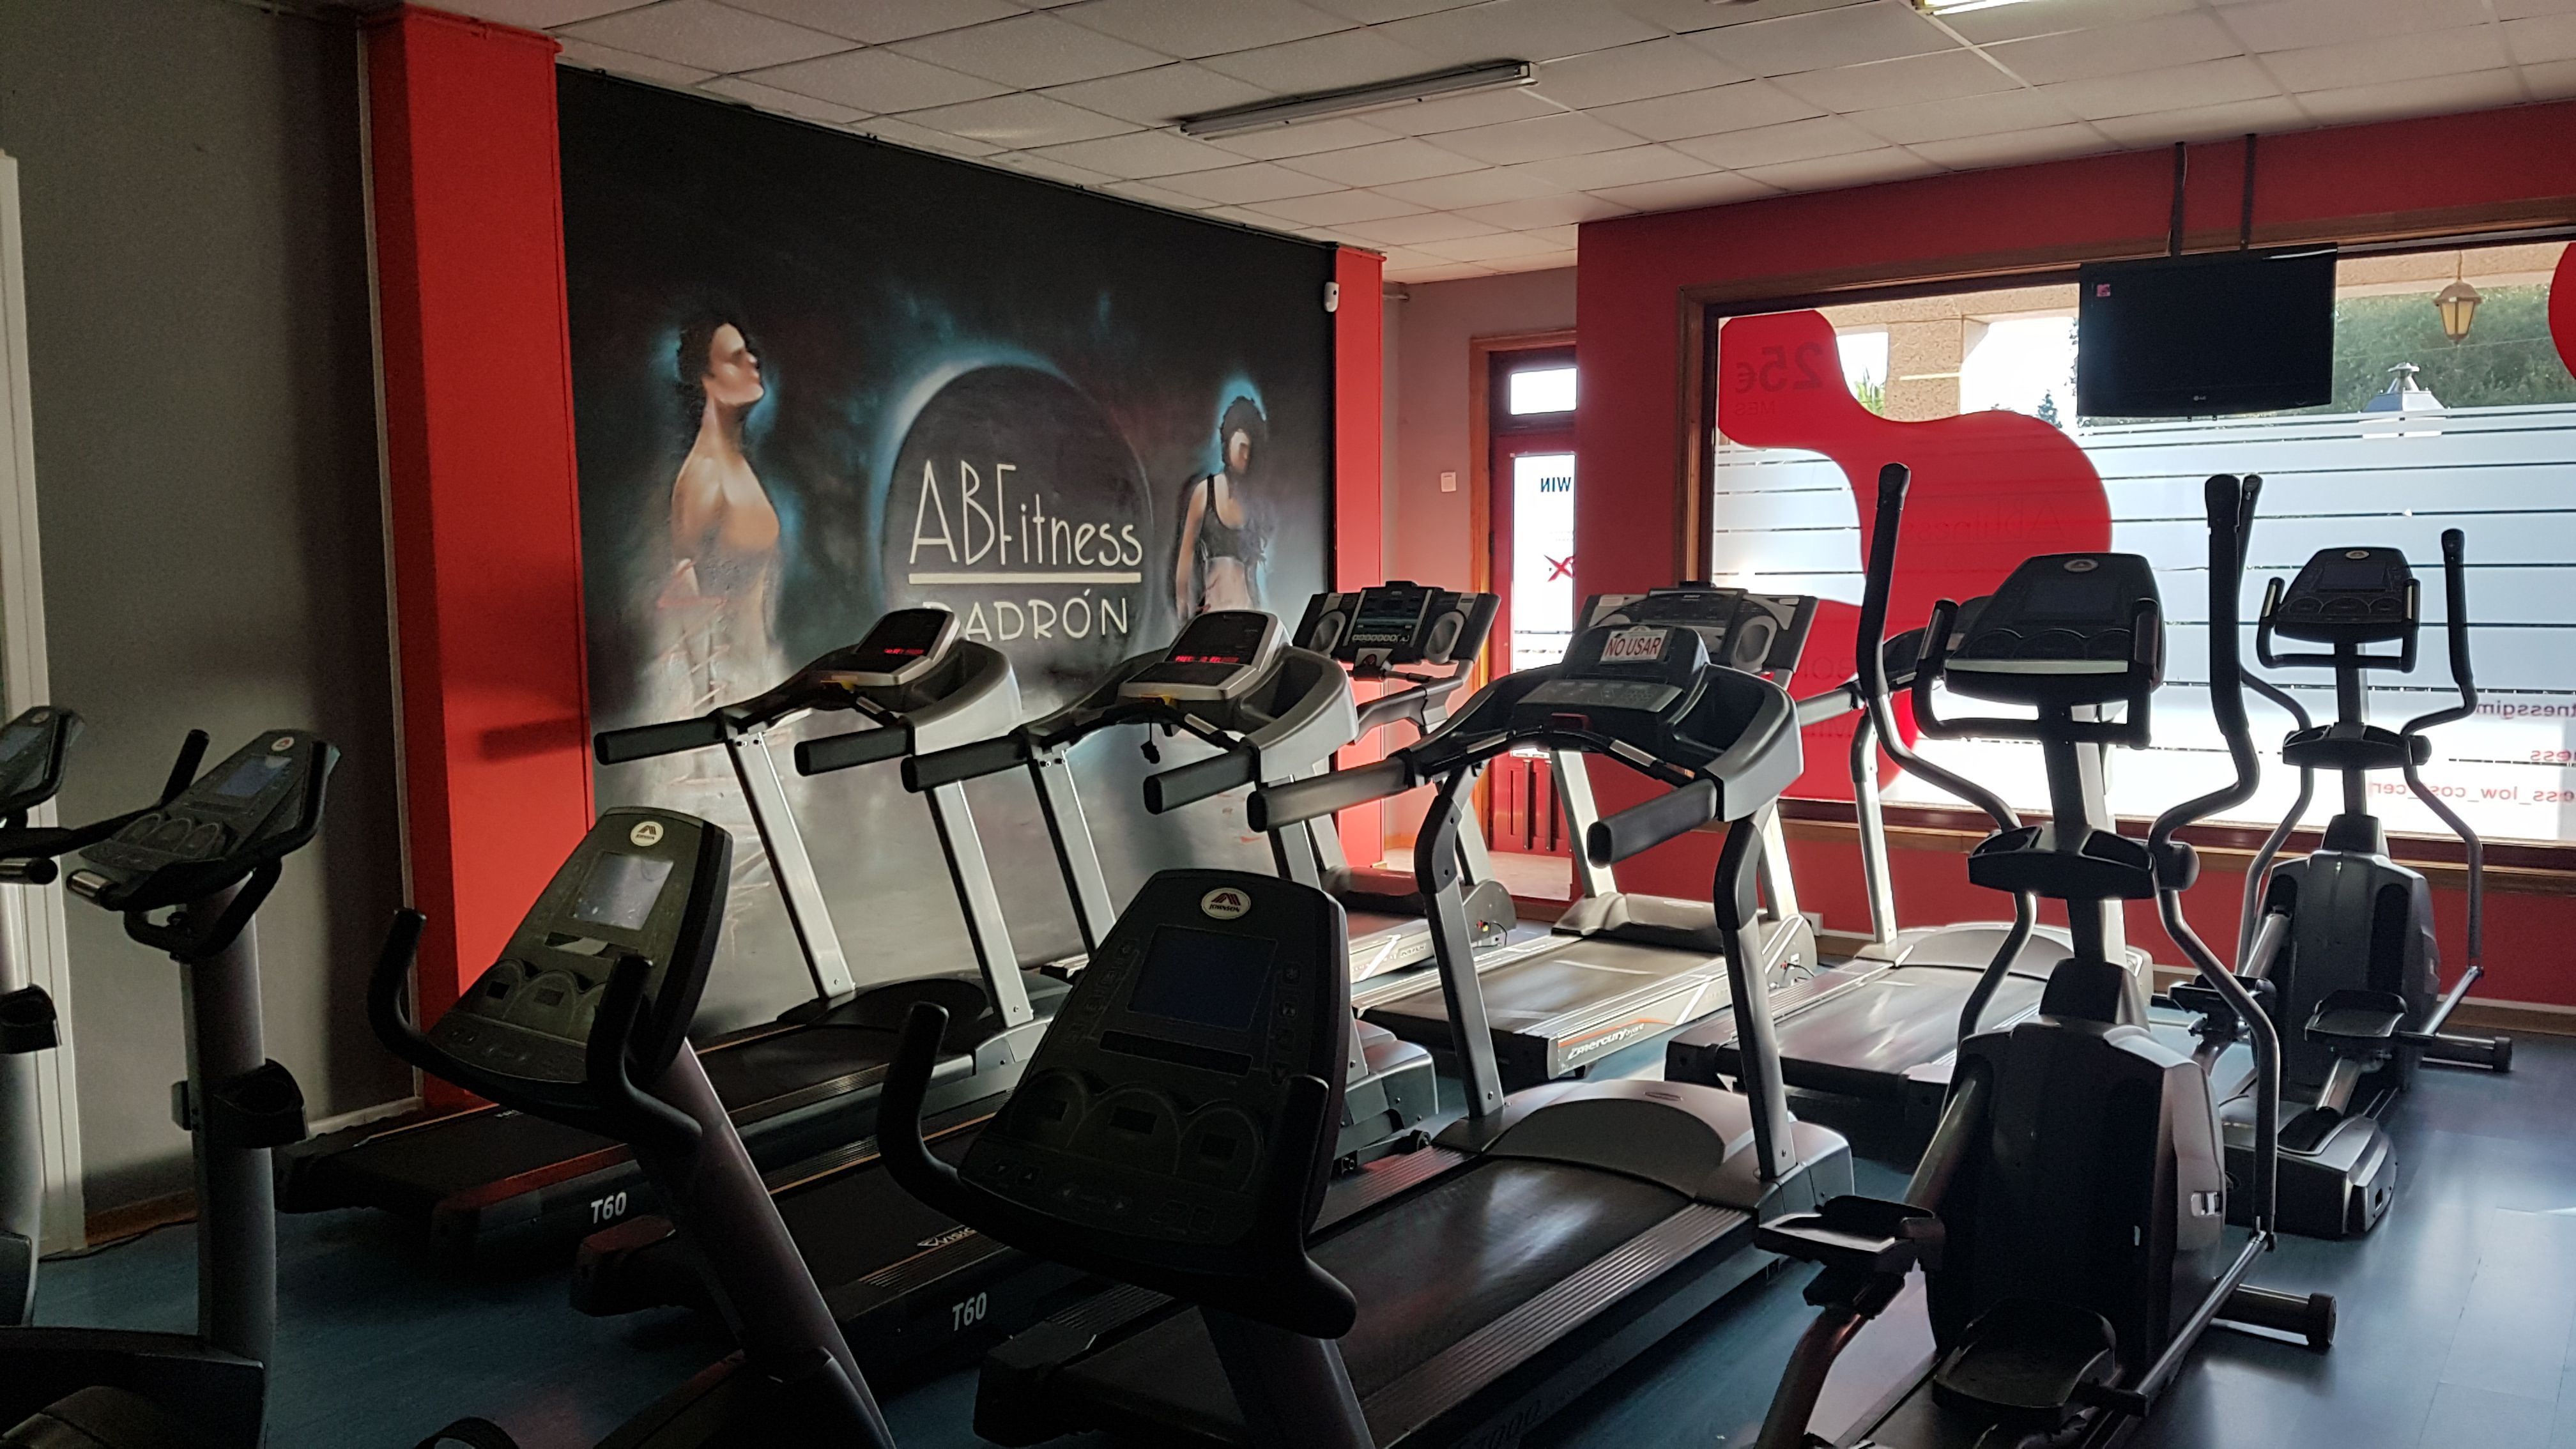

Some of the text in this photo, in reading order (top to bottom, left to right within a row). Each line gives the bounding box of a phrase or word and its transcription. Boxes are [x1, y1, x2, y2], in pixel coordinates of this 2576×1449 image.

[909, 459, 1143, 567] ABFitness
[1605, 637, 1662, 657] NO USAR
[590, 1190, 627, 1225] T60
[952, 1291, 988, 1332] T60
